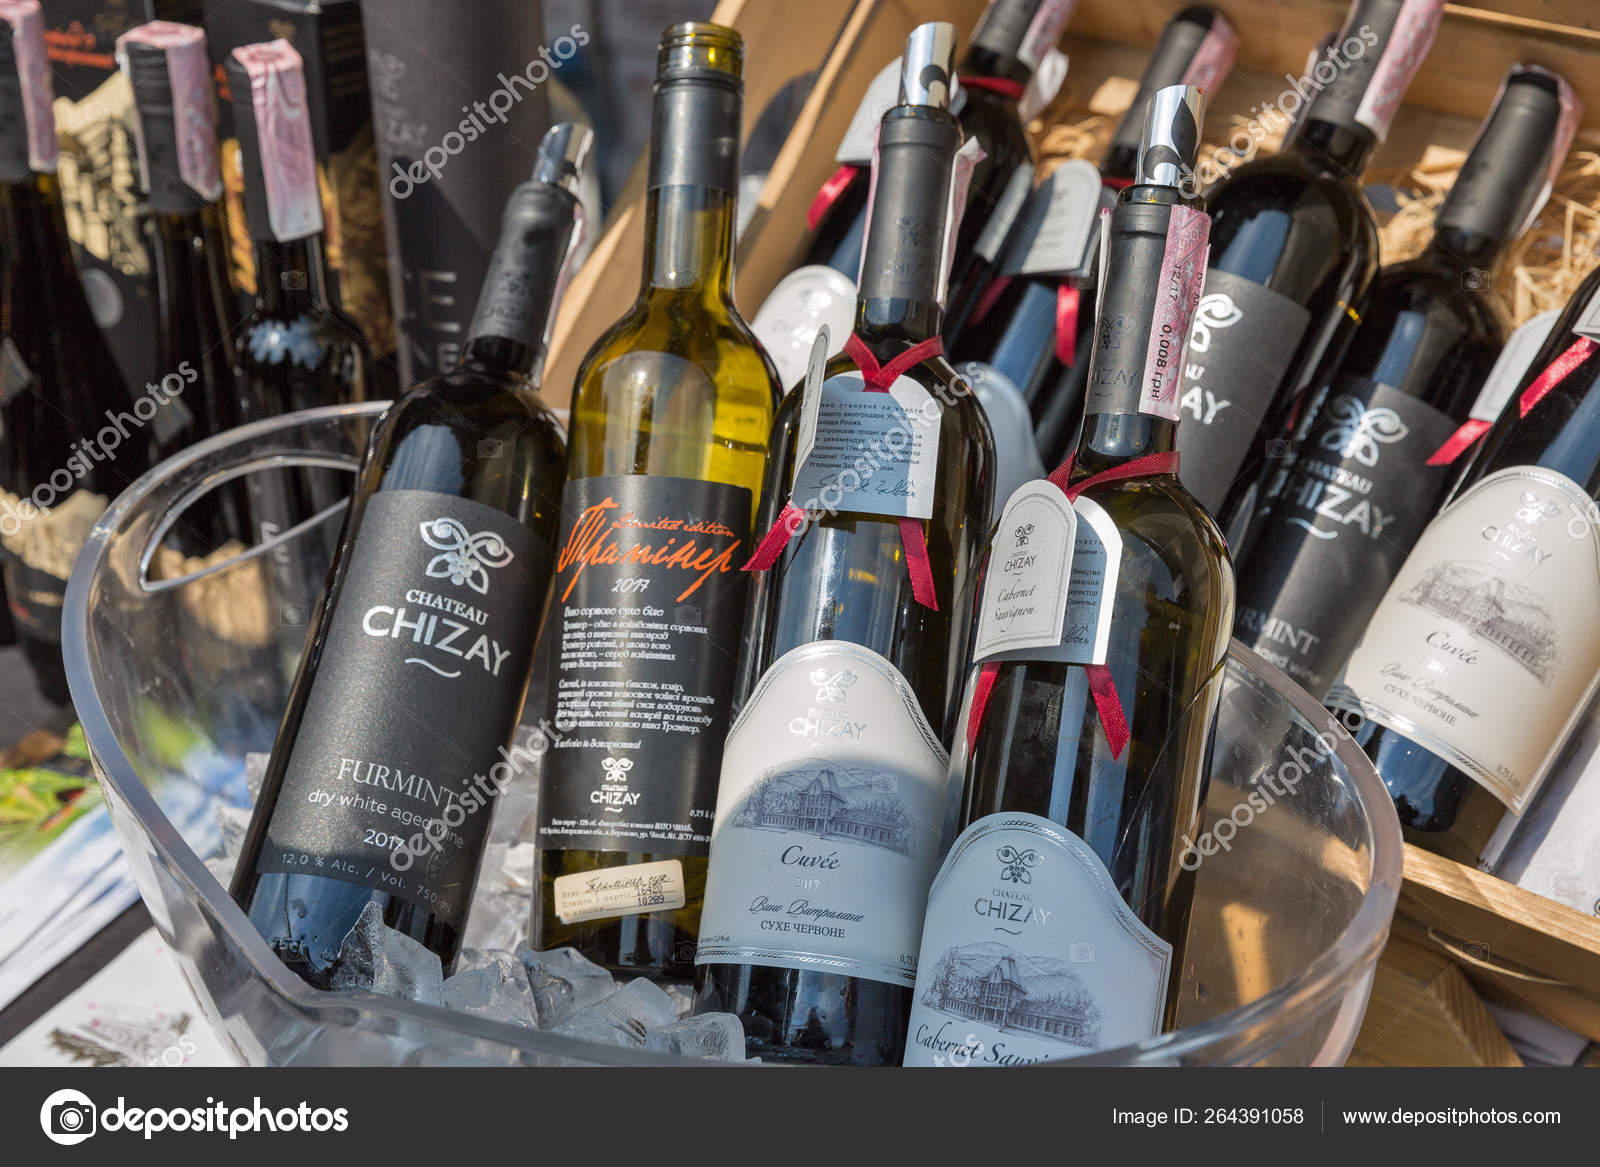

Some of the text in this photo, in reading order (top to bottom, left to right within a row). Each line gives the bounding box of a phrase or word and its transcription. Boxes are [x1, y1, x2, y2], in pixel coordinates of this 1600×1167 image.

[1151, 324, 1172, 399] 0,008 грн
[1004, 555, 1037, 573] CHIZAY
[611, 577, 650, 593] 2017
[405, 588, 490, 626] CHATEAU
[361, 604, 513, 678] CHIZAY
[1426, 631, 1479, 665] Cuvée
[789, 717, 867, 741] CHIZAY
[336, 758, 460, 814] FURMINT
[590, 790, 641, 806] CHIZAY
[308, 789, 335, 807] dry
[340, 793, 387, 815] white
[391, 807, 434, 826] aged
[363, 829, 405, 851] 2017
[281, 853, 309, 866] 12,0
[315, 856, 325, 868] %
[331, 859, 360, 875] Alc.
[381, 871, 406, 889] Vol.
[781, 845, 841, 870] Cuvée
[416, 885, 437, 903] 750
[974, 897, 1051, 928] CHIZAY
[761, 919, 845, 939] СУХЕ ЧЕРВОНЕ
[916, 1021, 982, 1059] Cabernet
